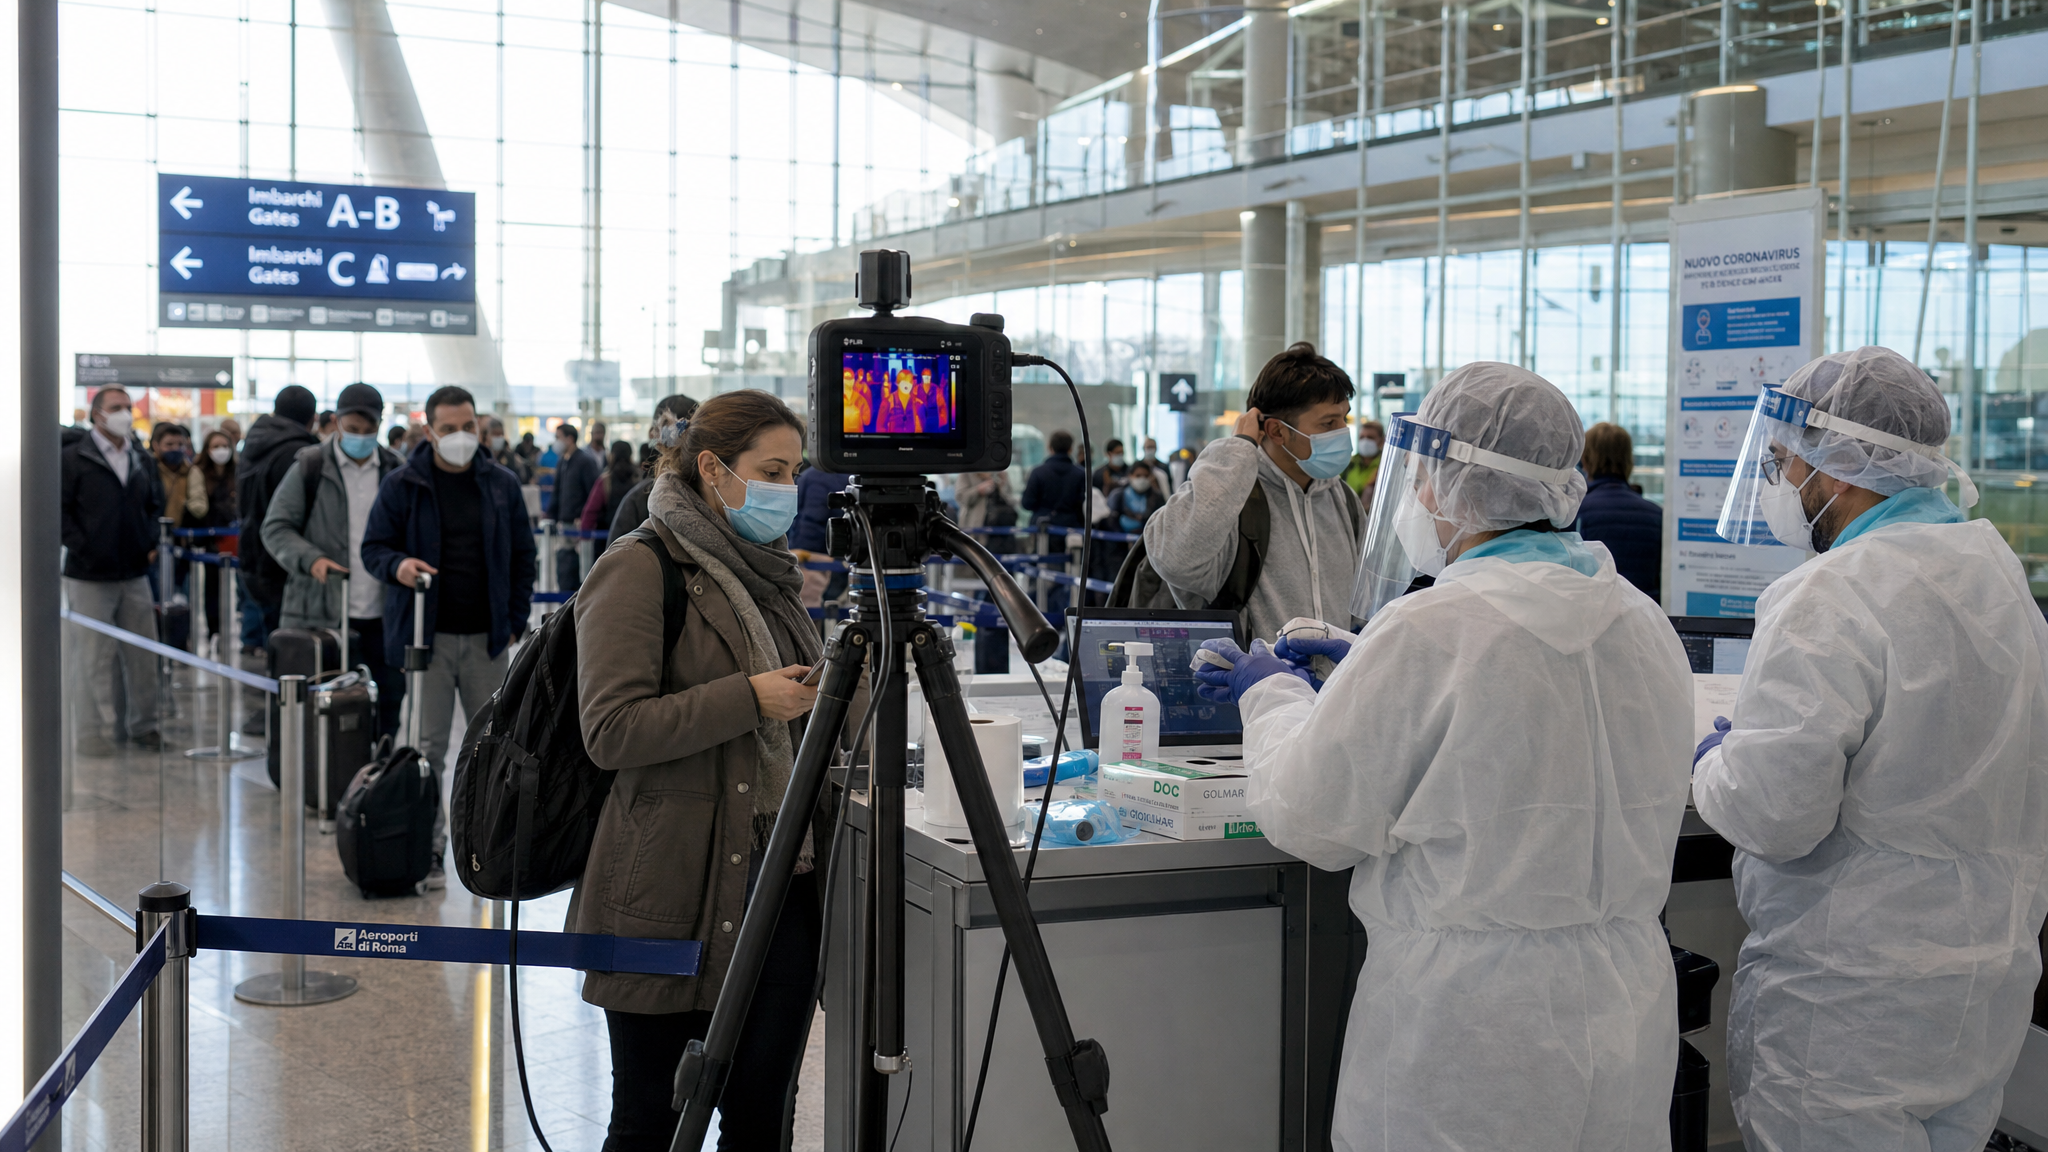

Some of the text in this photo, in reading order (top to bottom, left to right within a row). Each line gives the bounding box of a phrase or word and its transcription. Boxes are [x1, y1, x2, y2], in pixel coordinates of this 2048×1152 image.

[248, 187, 323, 208] Imbarchi
[248, 207, 300, 227] Gates
[327, 194, 401, 231] A-B
[248, 246, 323, 266] Imbarchi
[1684, 247, 1800, 269] NUOVO CORONAVIRUS
[248, 266, 300, 286] Gates
[327, 252, 356, 287] C
[1154, 780, 1180, 798] DOC
[1203, 789, 1244, 799] GOLMAR
[358, 929, 418, 943] Aeroporti
[358, 941, 407, 954] di Roma
